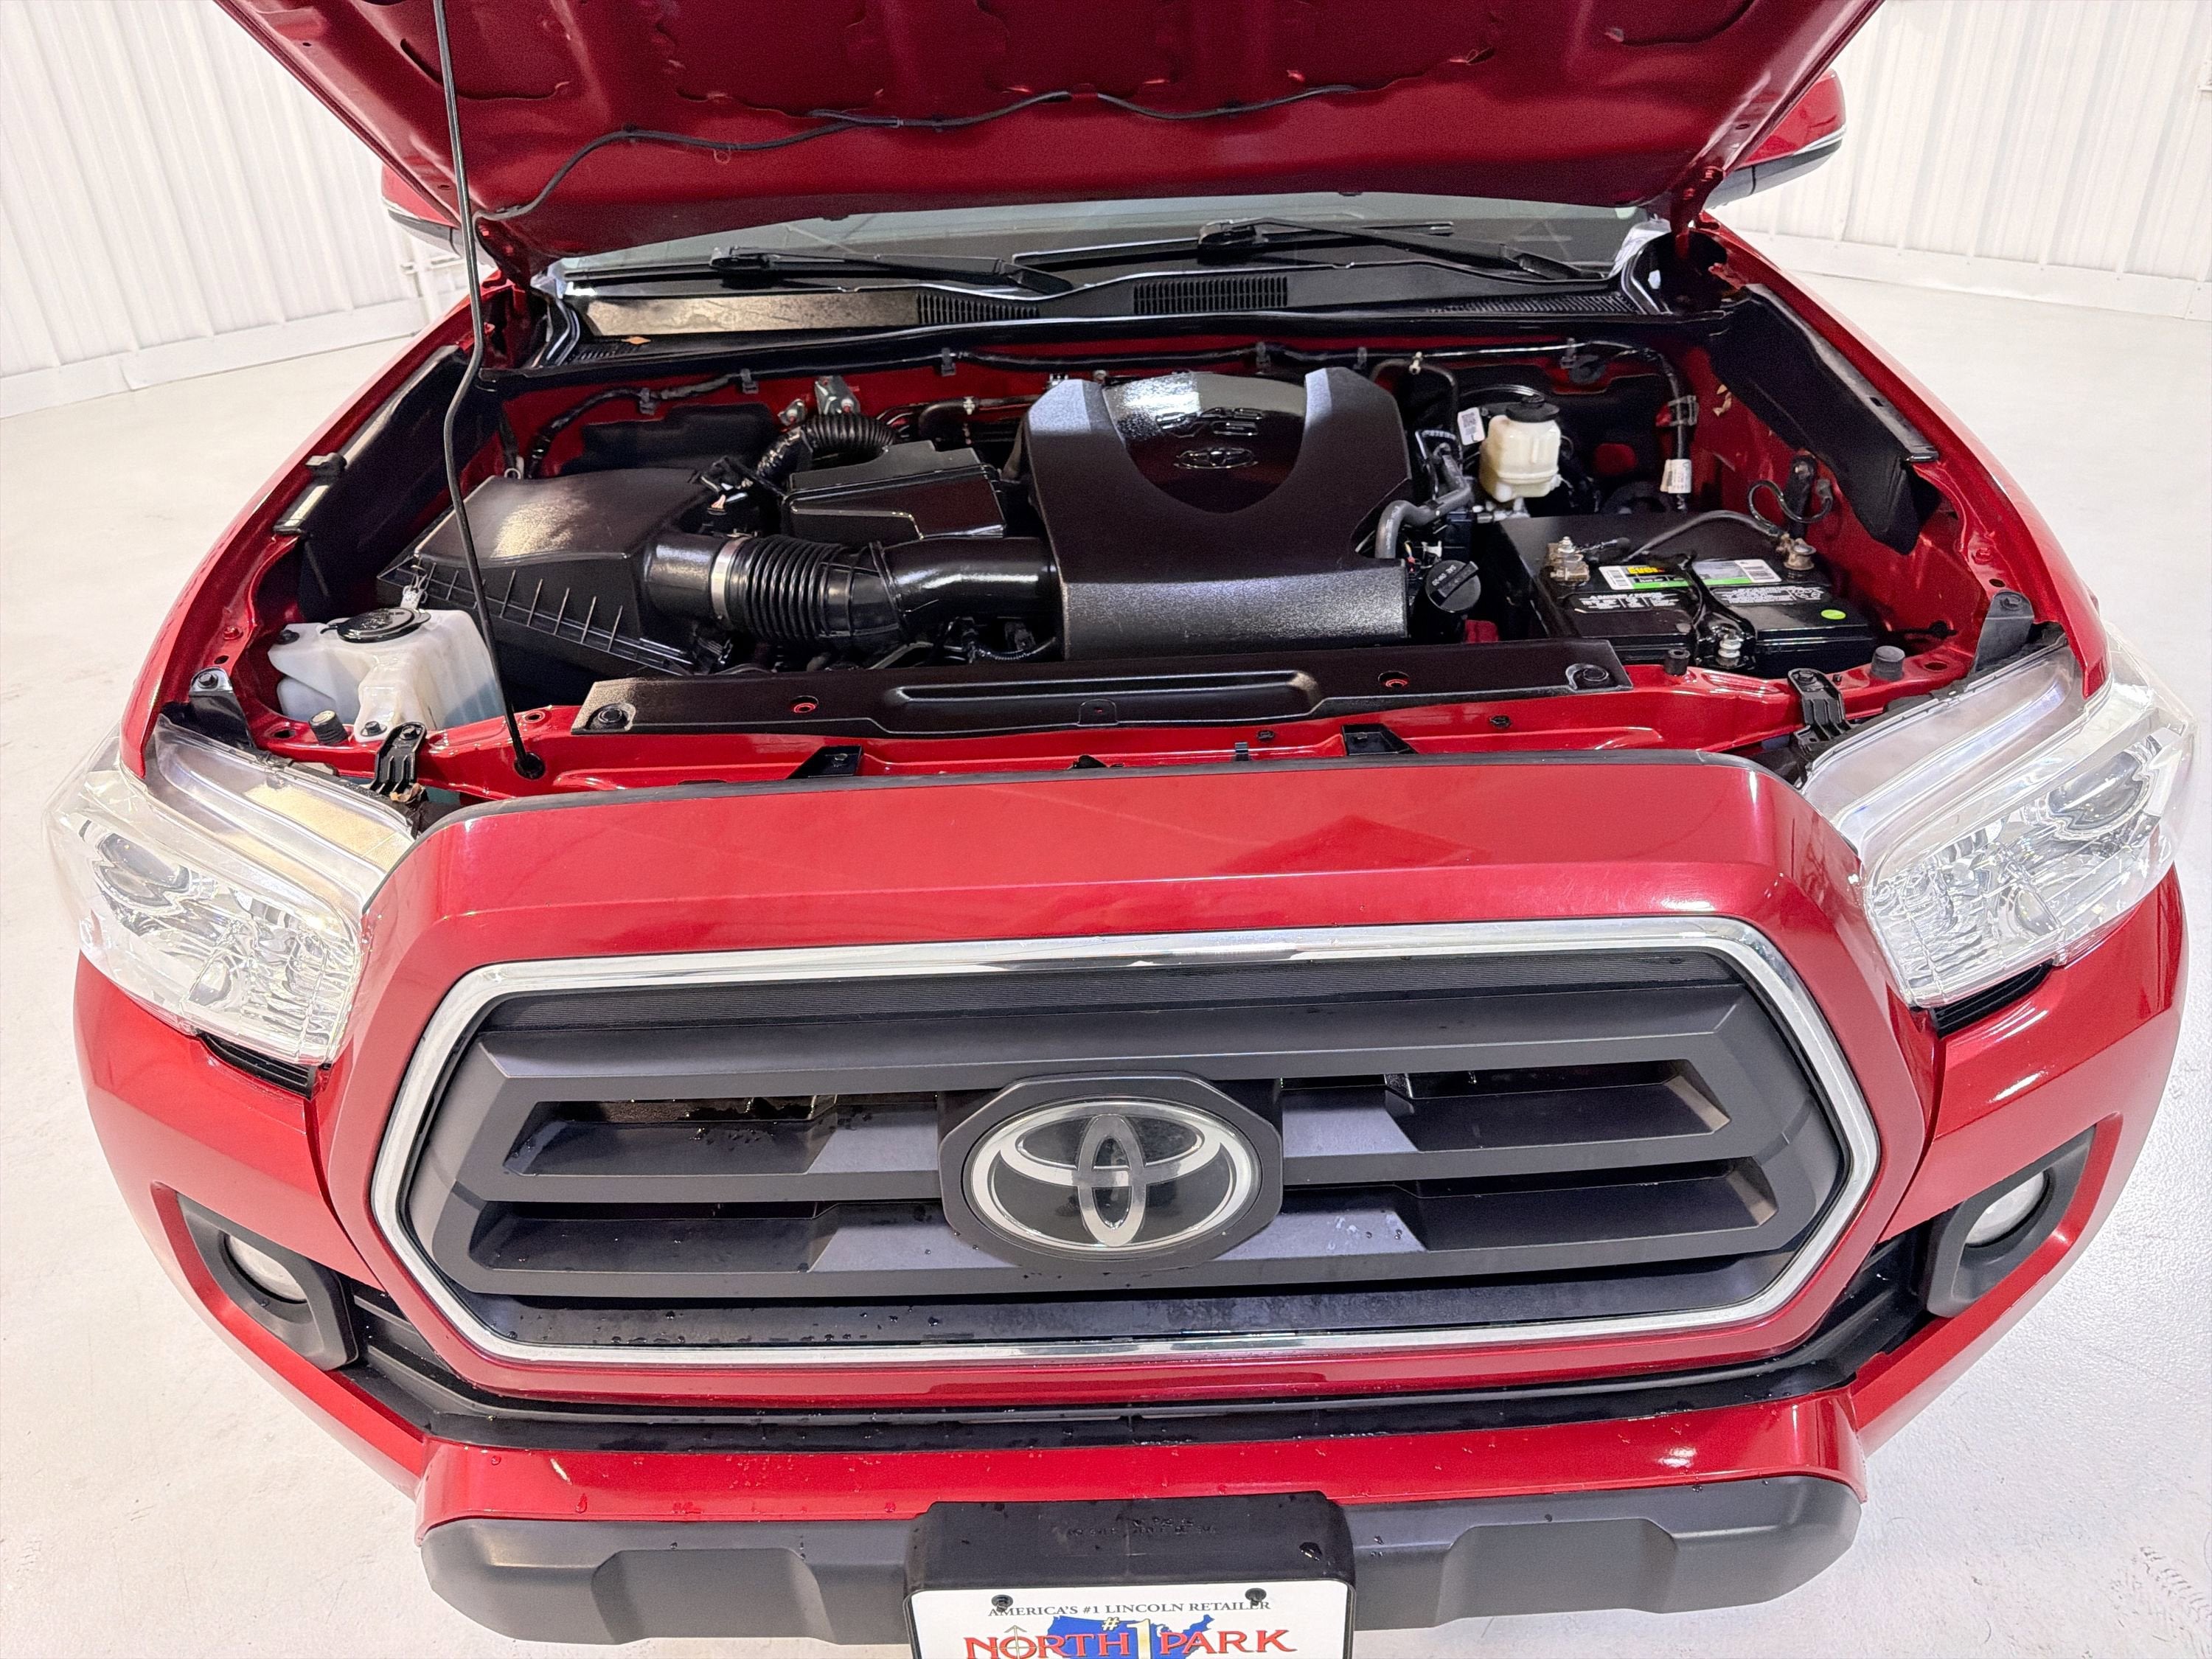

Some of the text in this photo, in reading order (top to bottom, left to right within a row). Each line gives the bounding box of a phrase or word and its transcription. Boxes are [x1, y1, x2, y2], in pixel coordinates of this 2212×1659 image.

[988, 1601, 1271, 1616] AMERICA'S #1 LINCOLN RETAILER
[964, 1630, 1298, 1659] NORTH PARK
